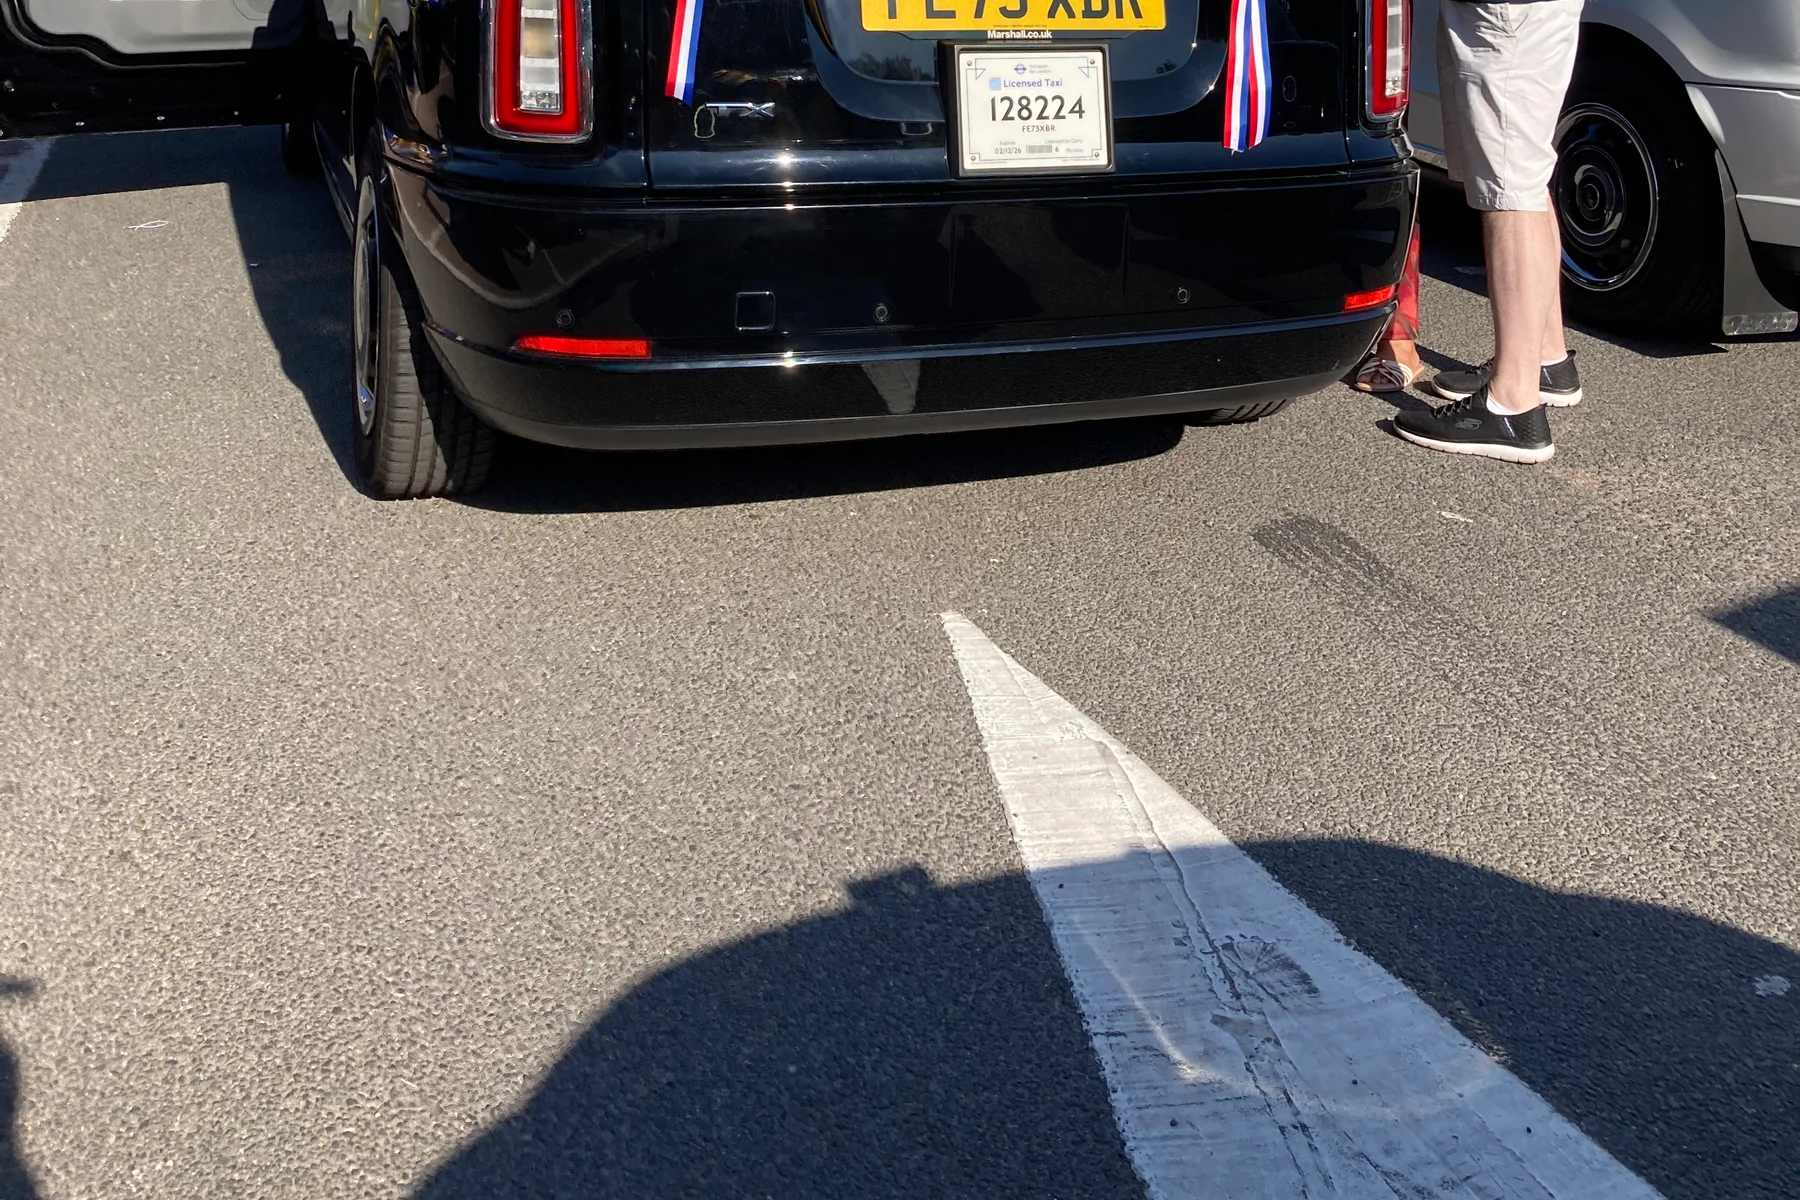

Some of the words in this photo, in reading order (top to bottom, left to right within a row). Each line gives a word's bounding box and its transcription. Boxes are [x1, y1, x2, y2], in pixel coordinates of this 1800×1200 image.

[987, 29, 1053, 39] Marshall.co.uk
[1003, 79, 1043, 88] Licensed
[1045, 79, 1063, 87] Taxi
[990, 94, 1086, 122] 128224
[1022, 125, 1056, 133] FE73XBR
[994, 147, 1022, 155] 02/12/26
